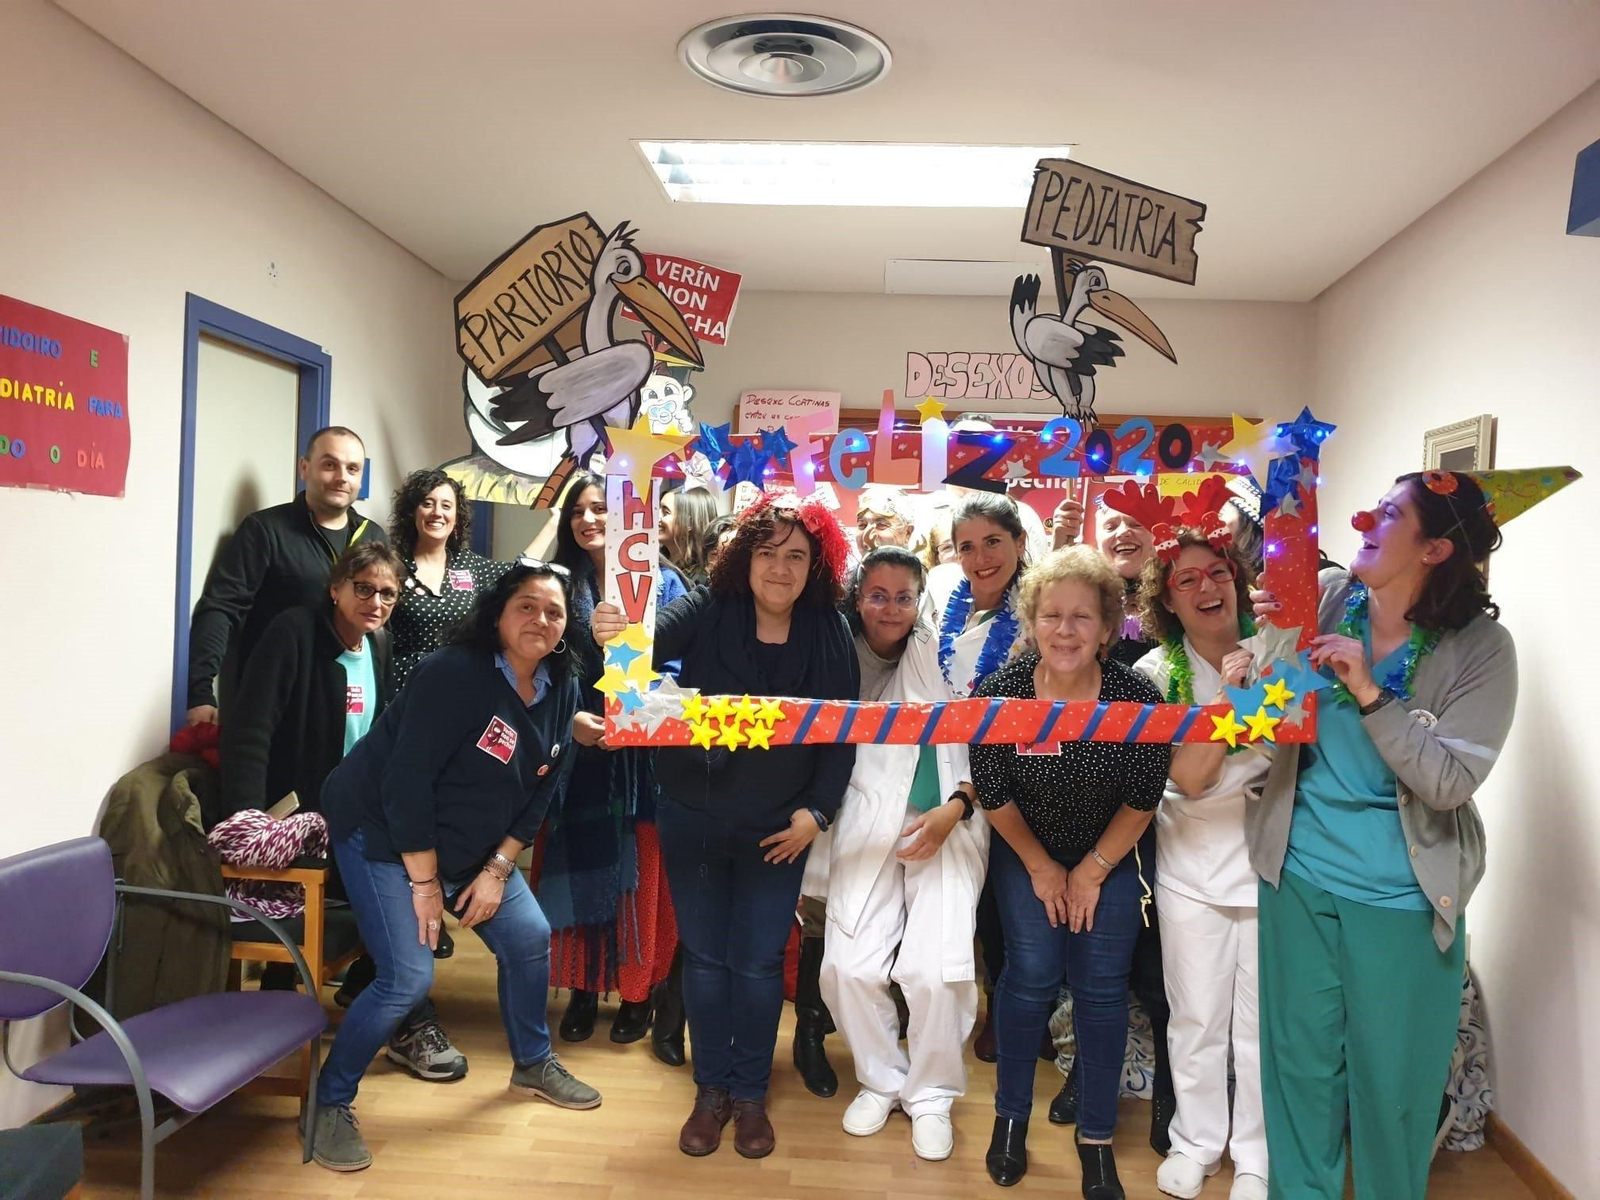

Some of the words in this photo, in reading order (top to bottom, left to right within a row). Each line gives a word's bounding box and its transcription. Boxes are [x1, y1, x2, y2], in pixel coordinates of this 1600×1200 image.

[1035, 170, 1177, 265] PEDIATRIA
[655, 258, 720, 292] VERÍN
[461, 229, 597, 365] PARITORIO
[657, 282, 708, 311] NON
[682, 312, 725, 339] CHA
[0, 324, 62, 360] IDOIRO
[90, 350, 99, 368] E
[87, 396, 123, 420] PARA
[50, 445, 61, 464] O
[1038, 416, 1193, 478] 2020
[615, 480, 654, 624] HCV
